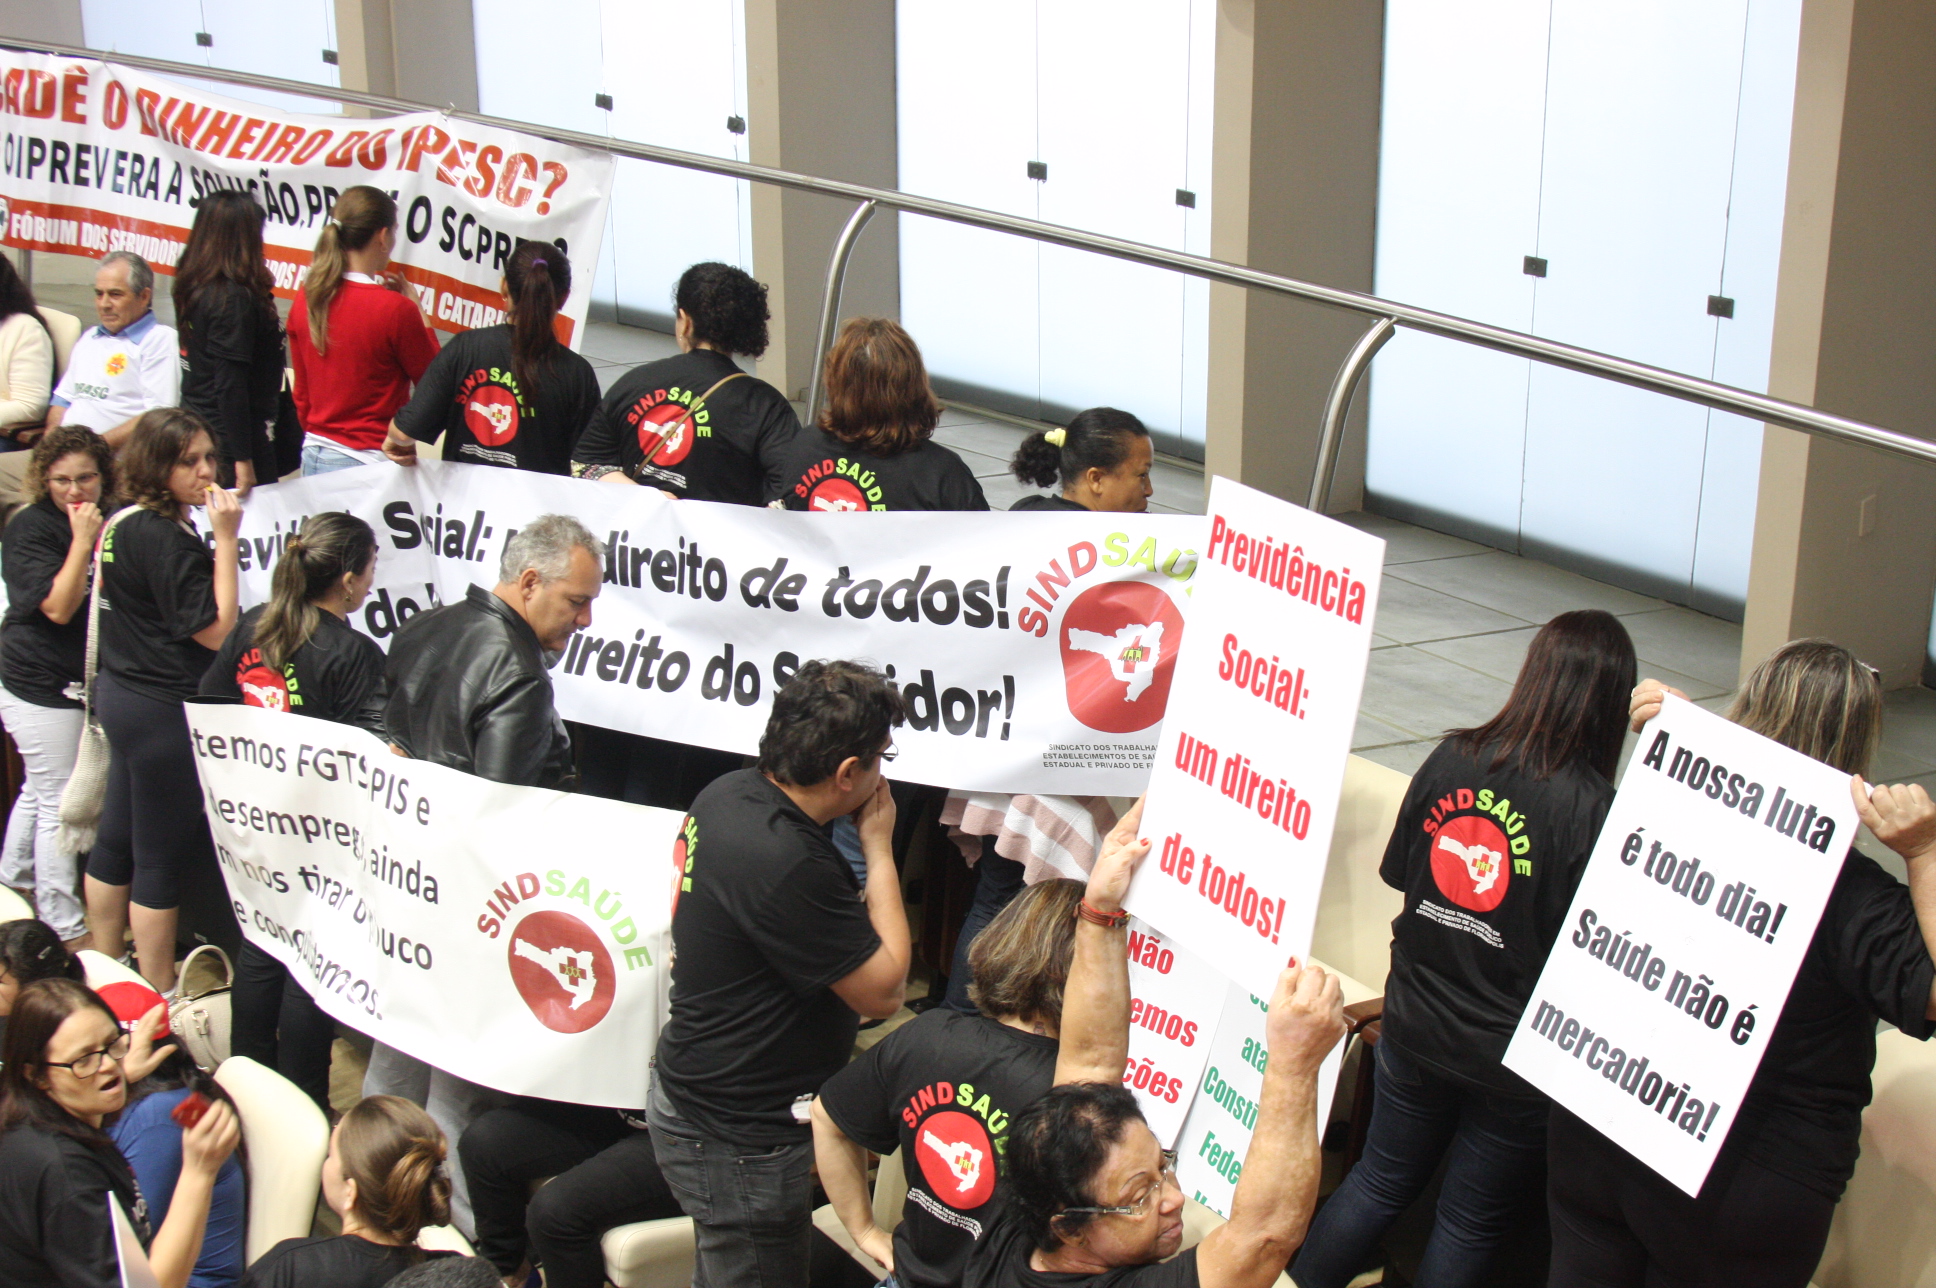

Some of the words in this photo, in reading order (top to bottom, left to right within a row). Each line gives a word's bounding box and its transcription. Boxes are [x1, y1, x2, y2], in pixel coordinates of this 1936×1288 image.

[0, 64, 90, 125] ADÊ
[103, 79, 129, 131] O
[136, 87, 334, 166] DINHEIRO
[325, 128, 396, 171] DO
[396, 124, 568, 216] IPESC?
[11, 210, 79, 246] FÓRUM
[80, 220, 109, 253] DOS
[166, 160, 183, 205] A
[406, 195, 432, 244] O
[438, 205, 568, 271] SCPR
[794, 457, 887, 512] SINDSAÚDE
[601, 530, 728, 603] direito
[739, 557, 808, 613] de
[821, 565, 1012, 630] todos!
[1018, 531, 1198, 639] SINDSAÚ
[1206, 513, 1367, 625] Previdência
[701, 643, 762, 706] do
[1218, 632, 1310, 720] Social:
[191, 727, 287, 773] temos
[416, 796, 431, 826] e
[1048, 743, 1091, 751] SINDICATO
[1174, 731, 1218, 787] um
[1219, 752, 1312, 841] direito
[1641, 729, 1671, 772] A
[1667, 744, 1766, 819] nossa
[1763, 786, 1837, 855] luta
[1423, 788, 1532, 877] SINDSAÚDE
[297, 863, 353, 912] tirar
[477, 869, 654, 971] SINDSAÚDE
[1159, 832, 1195, 886] de
[1197, 853, 1287, 945] todos!
[1619, 827, 1646, 867] é
[1644, 834, 1715, 906] todo
[1715, 880, 1789, 945] dia!
[1127, 929, 1175, 975] Não
[1571, 908, 1667, 992] Saúde
[1664, 972, 1730, 1031] não
[1729, 1003, 1760, 1046] é
[1529, 999, 1722, 1144] mercadoria!
[1198, 1130, 1243, 1185] Fede
